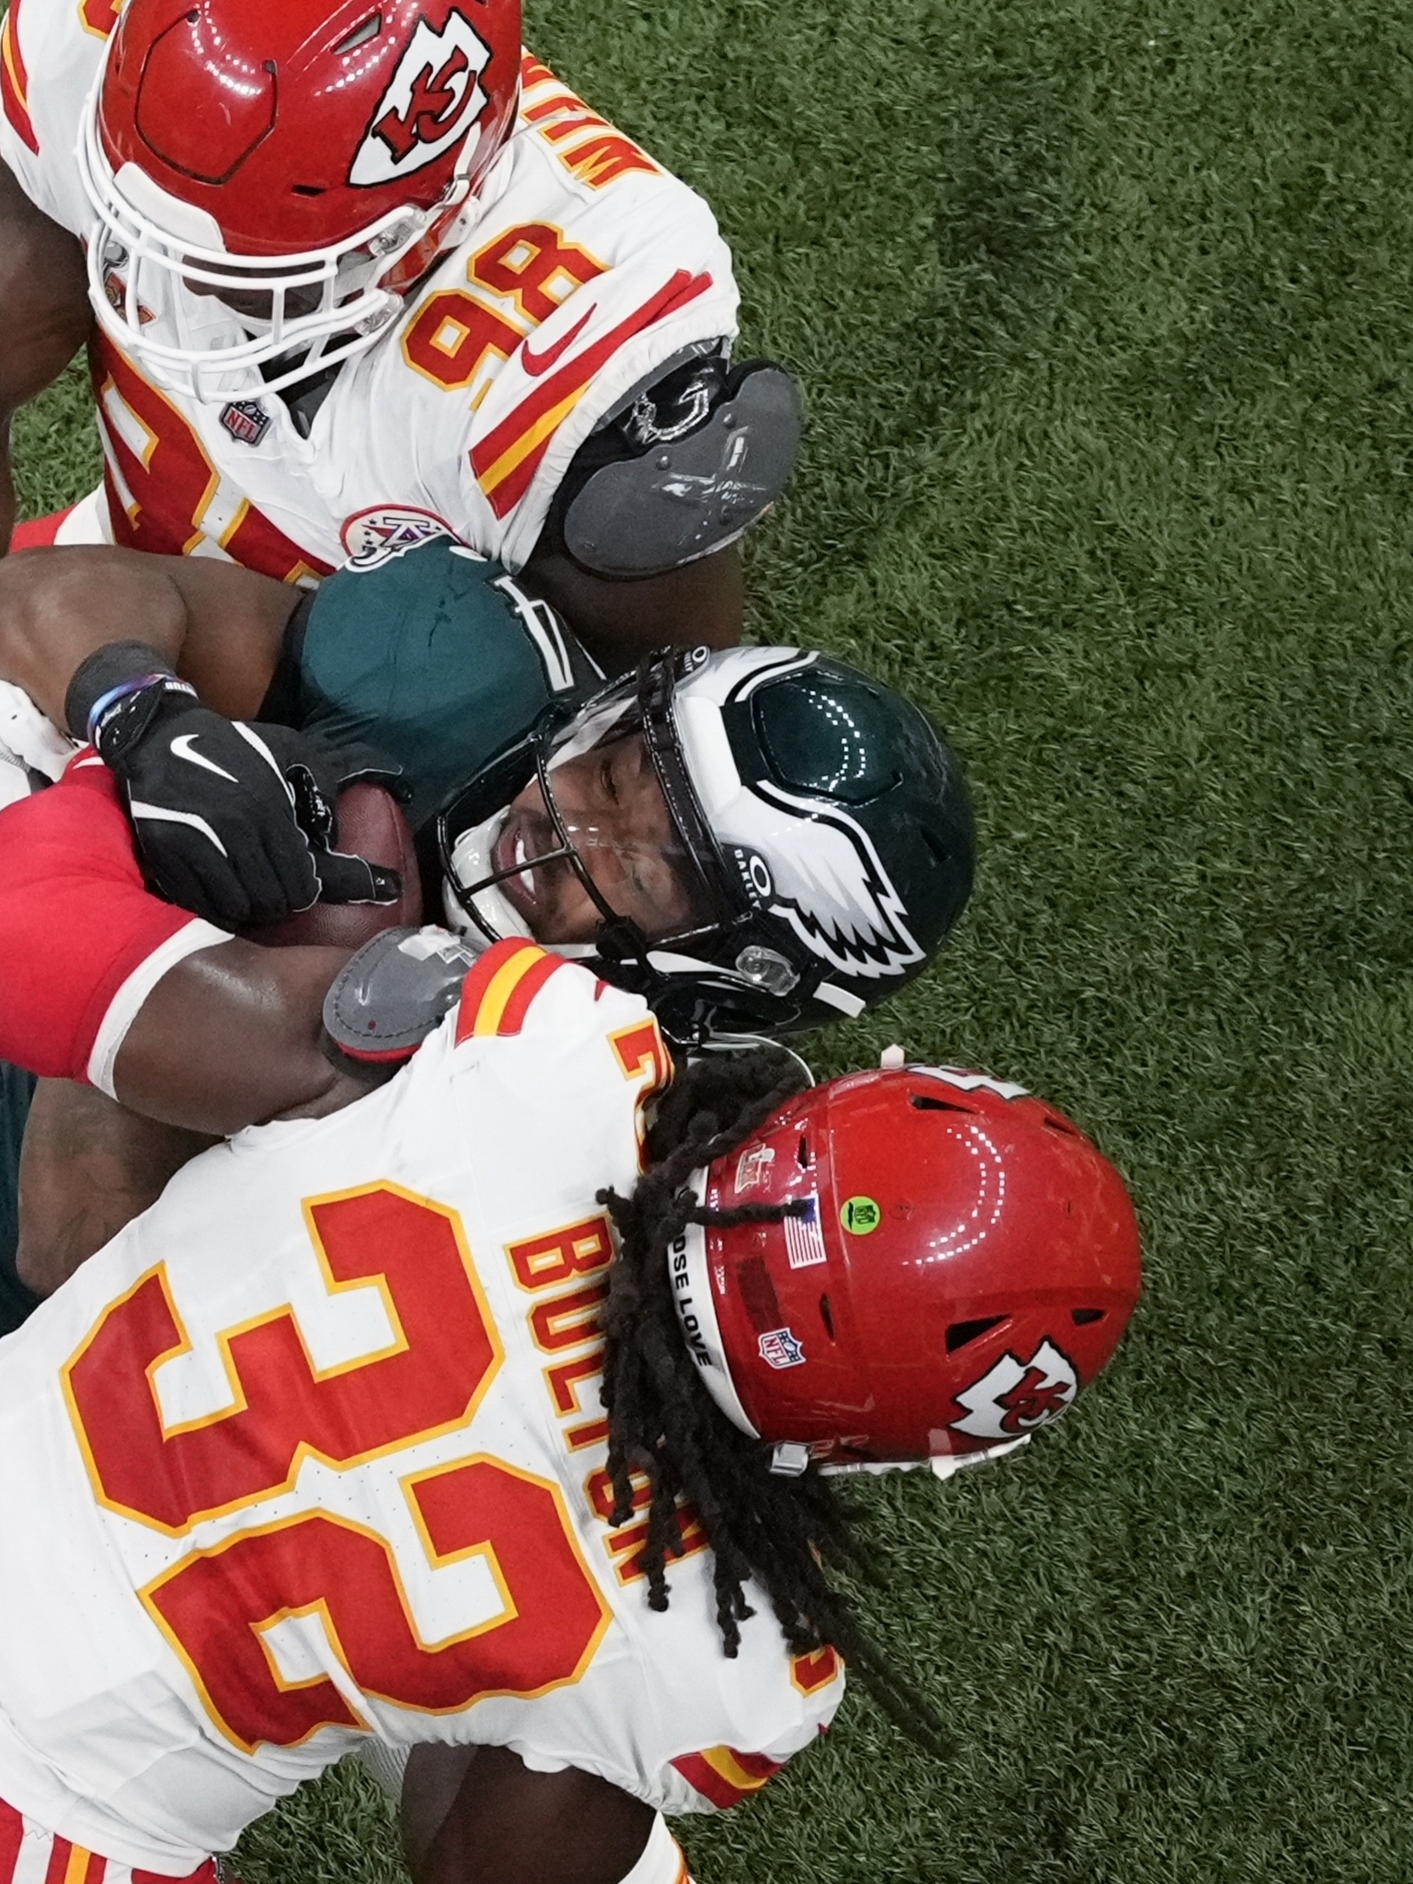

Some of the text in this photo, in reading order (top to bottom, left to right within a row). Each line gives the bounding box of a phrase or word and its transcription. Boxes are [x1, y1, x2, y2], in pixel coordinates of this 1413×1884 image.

[371, 44, 477, 165] KC
[400, 219, 615, 405] 98
[734, 848, 763, 911] OAKLEY
[679, 1297, 713, 1367] LOVE
[58, 1178, 614, 1756] 32
